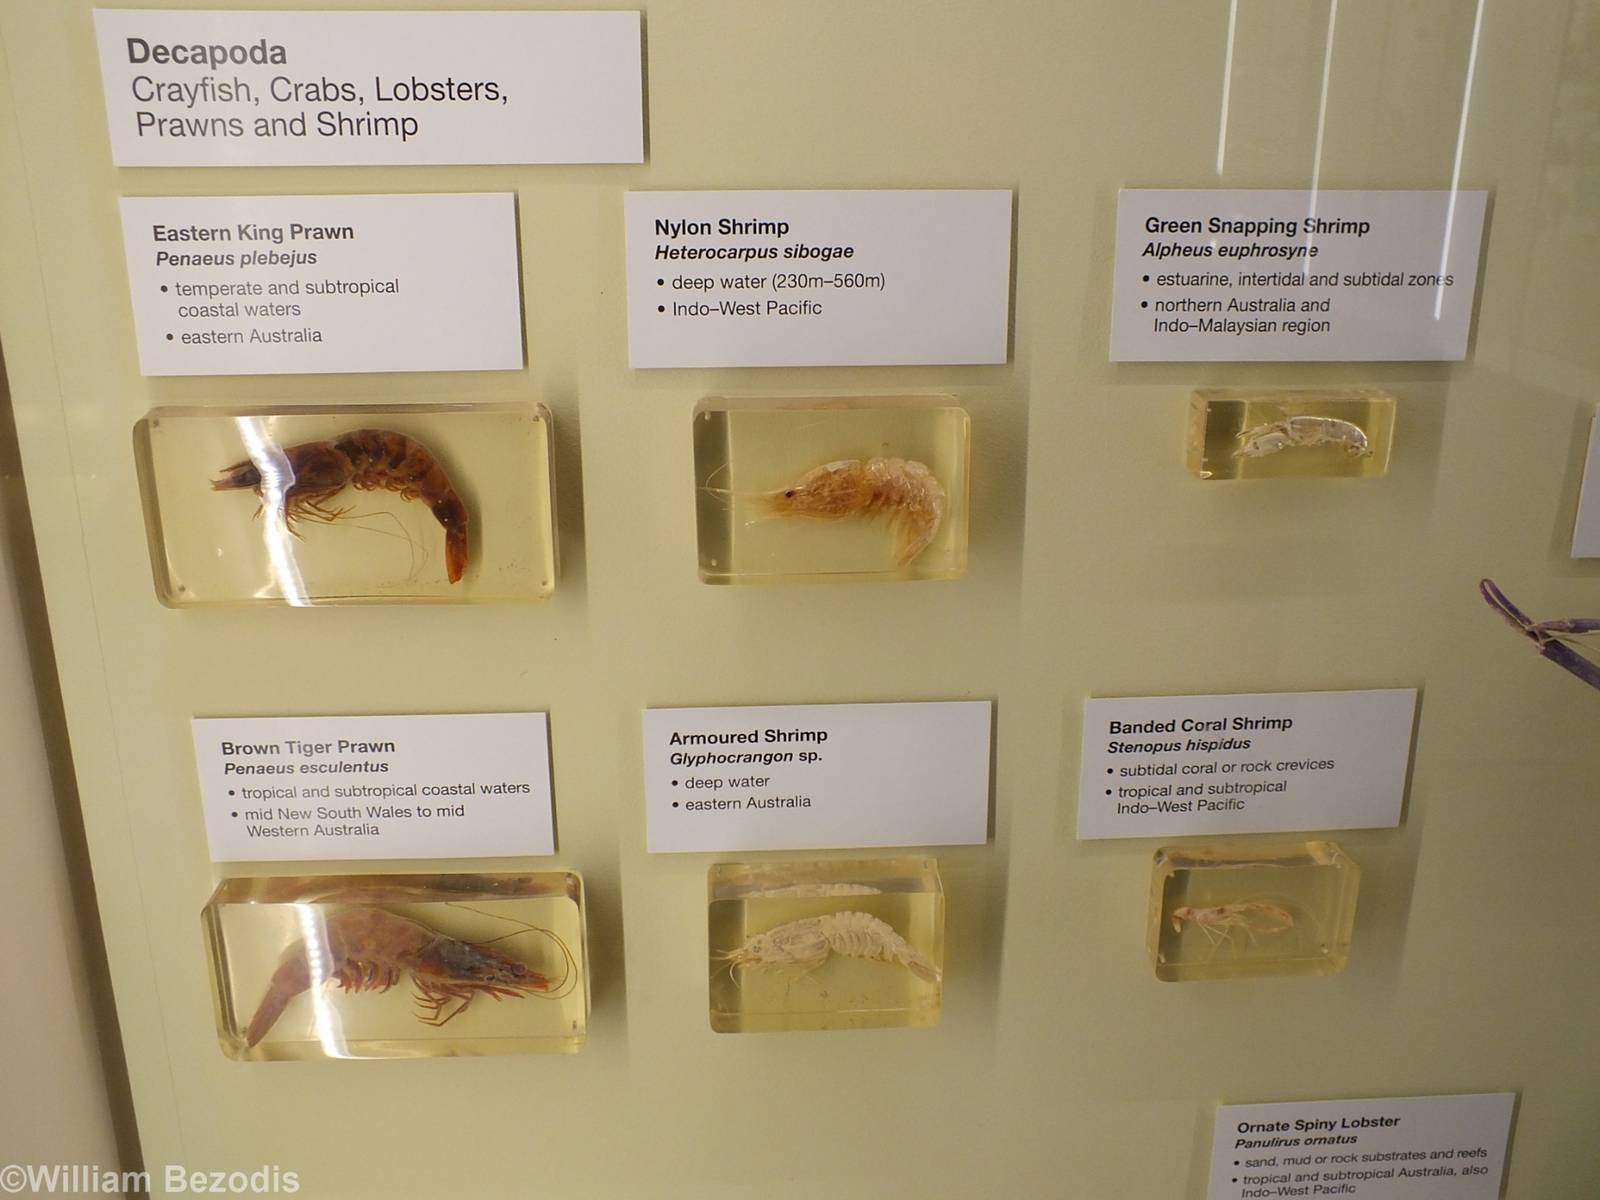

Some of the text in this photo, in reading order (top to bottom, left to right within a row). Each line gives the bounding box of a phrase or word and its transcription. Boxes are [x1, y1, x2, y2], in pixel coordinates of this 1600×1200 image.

[126, 38, 287, 70] Decapoda
[132, 75, 507, 109] Crayfish, Crabs, Lobsters,
[136, 111, 418, 142] Prawns and Shrimp
[152, 224, 354, 244] Eastern King Prawn
[655, 218, 789, 239] Nylon Shrimp
[1145, 216, 1370, 238] Green Snapping Shrimp
[156, 250, 317, 269] Penaeus plebejus
[655, 244, 854, 262] Heterocarpus sibogae
[1142, 242, 1318, 260] Alpheus euphrosyne
[175, 278, 399, 300] temperate and subtropical
[672, 274, 714, 293] deep
[720, 274, 767, 289] water
[1156, 272, 1454, 288] estuarine, intertidal and subtidal zones
[178, 302, 301, 318] coastal waters
[767, 300, 822, 315] Pacific
[1155, 298, 1331, 312] northern Australia and
[181, 328, 323, 344] eastern Australia
[1282, 321, 1330, 336] region
[1110, 716, 1293, 734] Banded Coral Shrimp
[669, 728, 828, 746] Armoured Shrimp
[221, 740, 395, 758] Brown Tiger Prawn
[1107, 738, 1252, 755] Stenopus hispidus
[224, 761, 389, 775] Penaeus esculentus
[670, 752, 822, 768] Glyphocrangon sp.
[1120, 760, 1335, 777] subtidal coral or rock crevices
[241, 782, 530, 802] tropical and subtropical coastal waters
[685, 776, 770, 791] deep water
[1118, 780, 1287, 800] tropical and subtropical
[245, 804, 464, 820] mid New South Wales to mid
[685, 795, 812, 811] eastern Australia
[1197, 798, 1245, 811] Pacific
[246, 823, 380, 838] Western Australia
[1237, 1116, 1401, 1134] Ornate Spiny Lobster
[1234, 1135, 1358, 1149] Panulirus ornatus
[1245, 1147, 1488, 1168] sand, mud or rock substrates and reefs
[1243, 1164, 1489, 1186] tropical and subtropical Australia, also
[1313, 1183, 1356, 1194] Pacific
